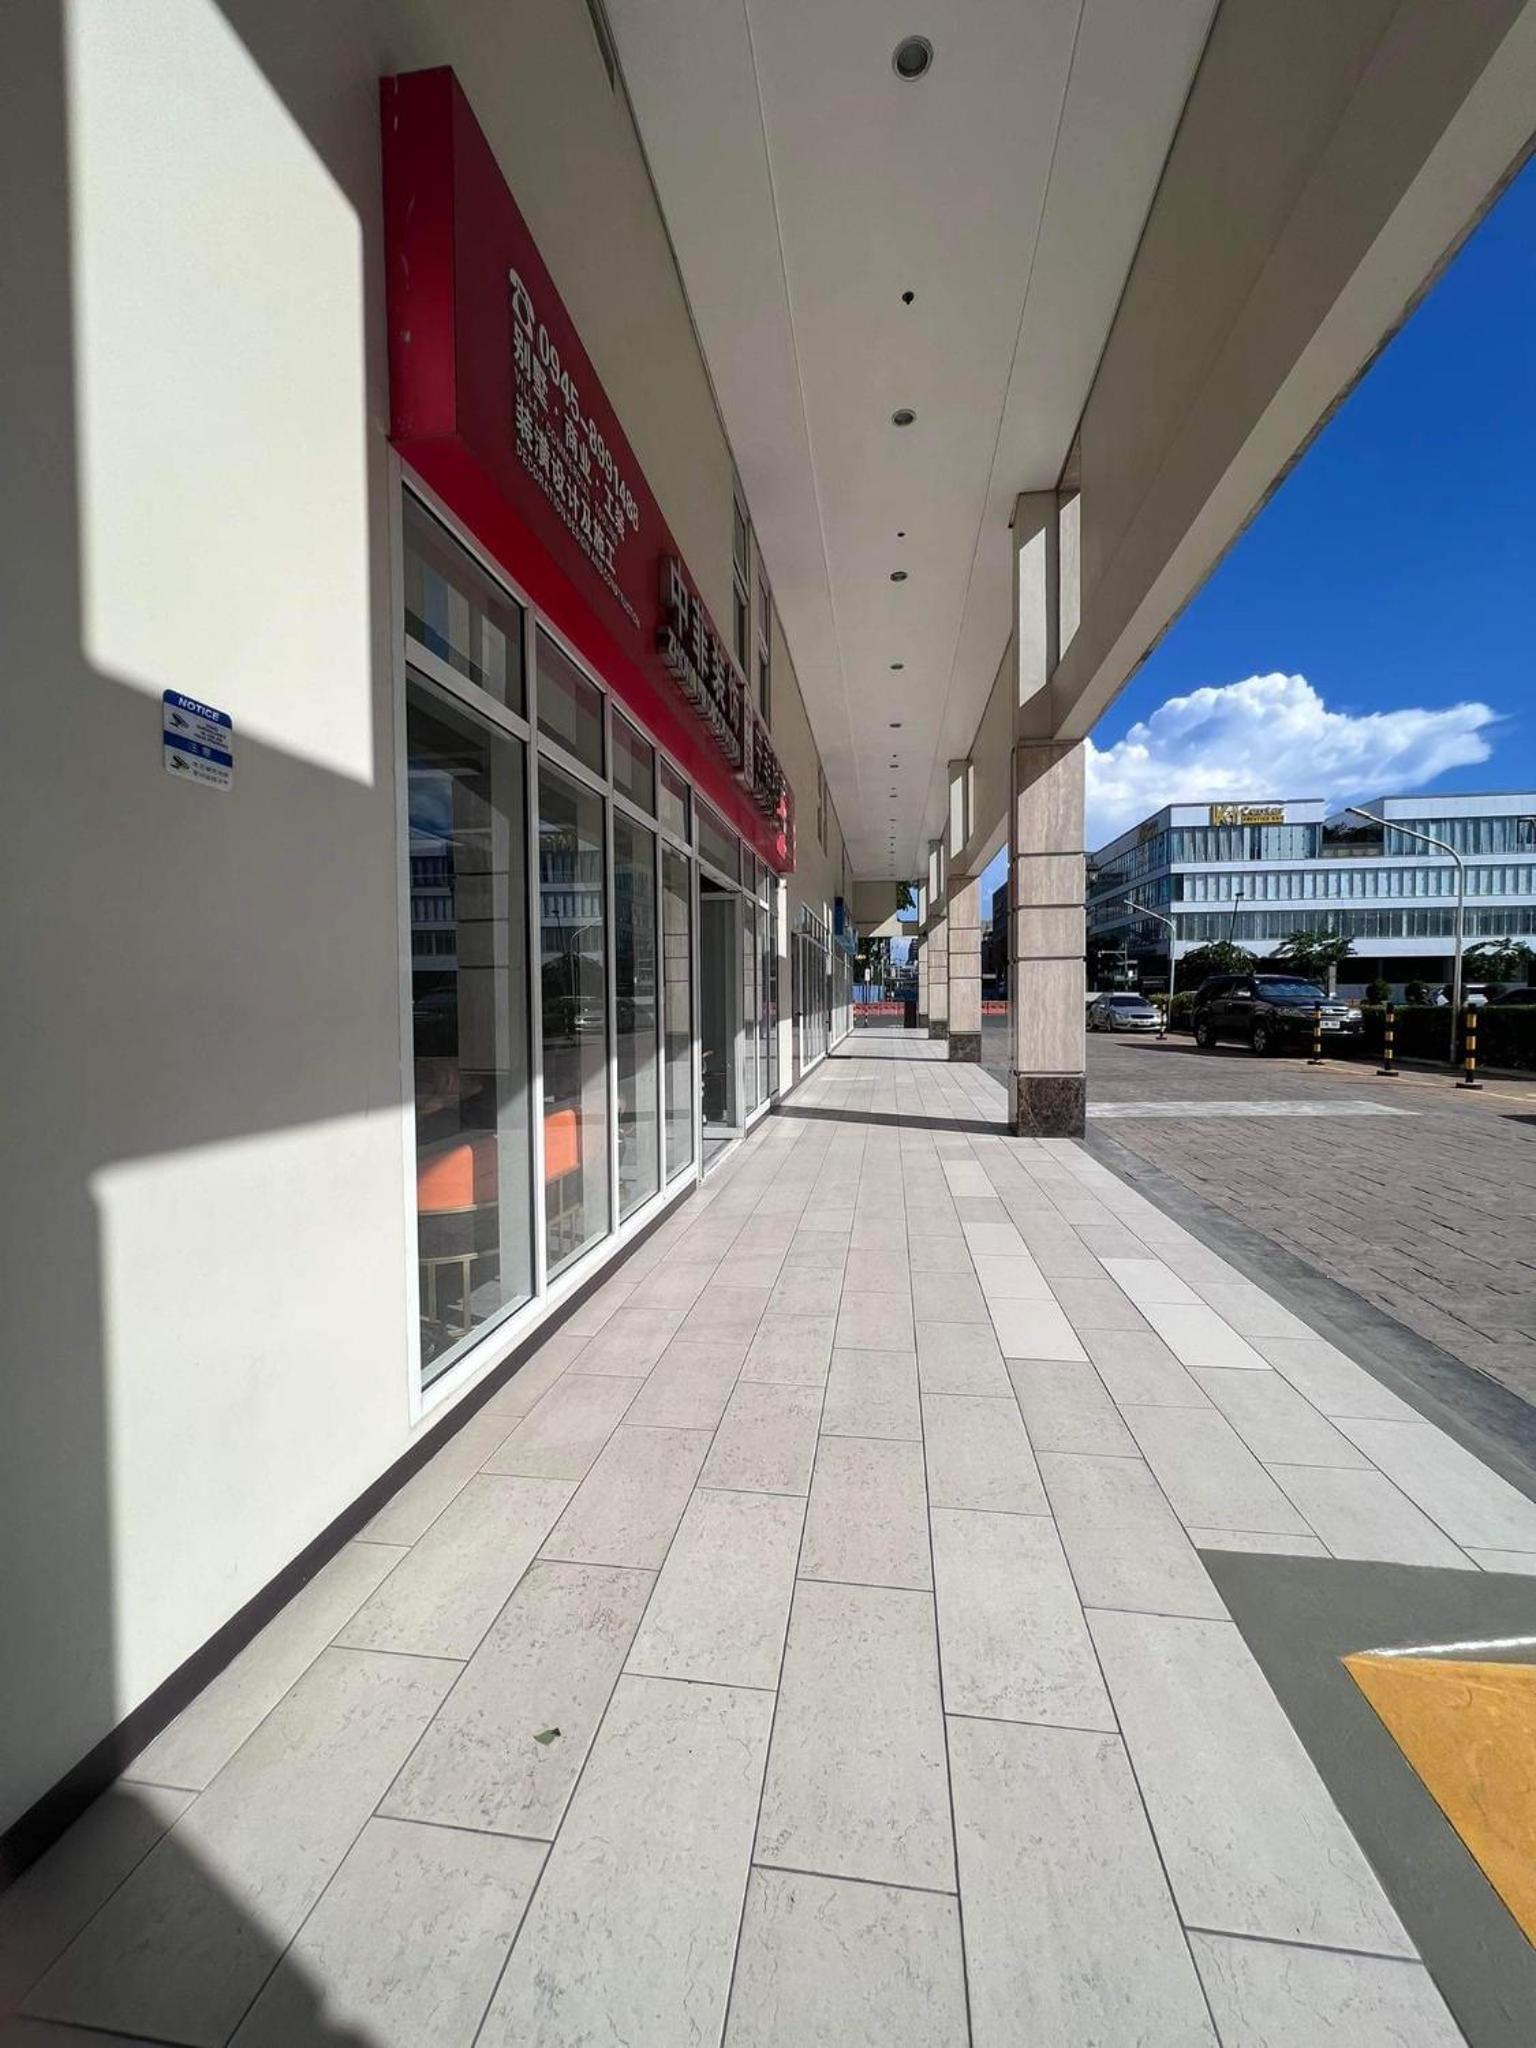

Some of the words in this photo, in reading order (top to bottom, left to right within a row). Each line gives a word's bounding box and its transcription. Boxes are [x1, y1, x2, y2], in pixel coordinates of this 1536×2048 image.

[516, 439, 566, 521] DECORATION
[516, 391, 616, 576] 装潢设计及施工
[177, 697, 220, 721] NOTICE
